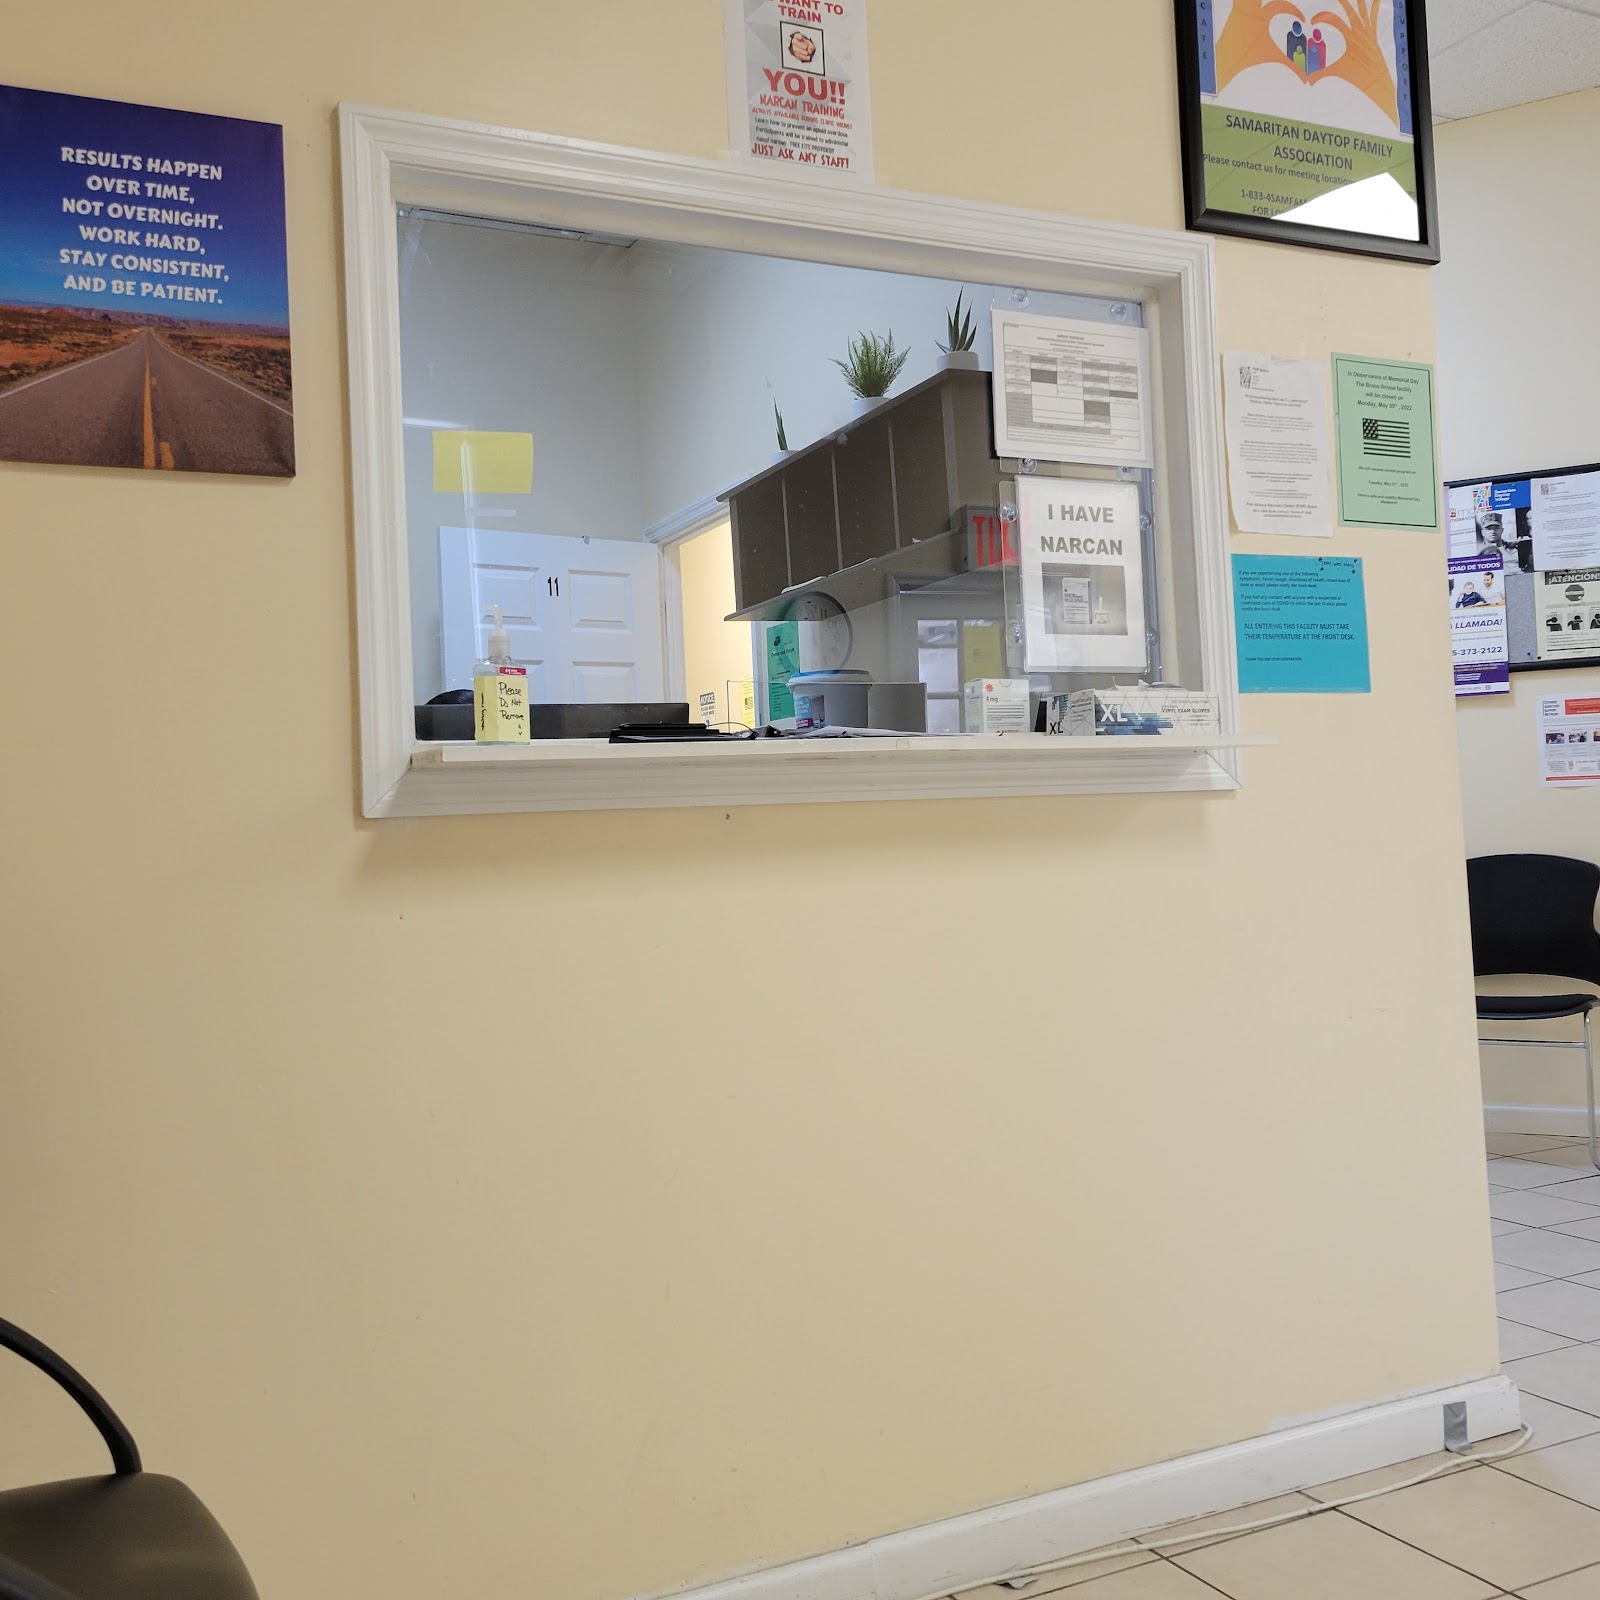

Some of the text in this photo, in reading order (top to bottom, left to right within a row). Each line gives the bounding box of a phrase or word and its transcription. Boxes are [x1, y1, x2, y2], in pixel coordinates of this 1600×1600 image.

[778, 5, 821, 23] TRAIN
[824, 2, 844, 15] TO
[762, 68, 845, 105] YOU!!
[760, 94, 845, 120] NARCAN TRAINING
[787, 122, 805, 131] prevent
[1226, 114, 1393, 158] SAMARITAN DAYTOP FAMILY
[61, 146, 222, 180] RESULTS HAPPEN
[751, 143, 849, 169] JUST ASK ANY STAFF!
[1273, 145, 1353, 170] ASSOCIATION
[1203, 153, 1230, 167] Please
[1232, 159, 1263, 171] contact
[1264, 164, 1274, 173] us
[1275, 165, 1287, 175] for
[1288, 169, 1320, 183] meeting
[86, 175, 195, 204] OVER TIME,
[62, 198, 223, 230] NOT OVERNIGHT.
[1252, 205, 1268, 218] FOR
[79, 225, 205, 255] WORK HARD,
[59, 249, 229, 282] STAY CONSISTENT,
[63, 274, 223, 304] AND BE PATIENT.
[1353, 371, 1382, 380] Observance
[1388, 375, 1409, 383] Memorial
[1410, 377, 1419, 385] Day
[1048, 504, 1114, 523] I HAVE
[1040, 536, 1123, 556] NARCAN
[548, 577, 559, 596] 11
[1255, 622, 1282, 630] ENTERING
[1455, 618, 1503, 629] LLAMADA!
[498, 681, 522, 696] Please
[498, 697, 523, 708] Do Not
[499, 709, 525, 721] Remove
[1101, 704, 1128, 722] XL
[1049, 720, 1063, 735] XL
